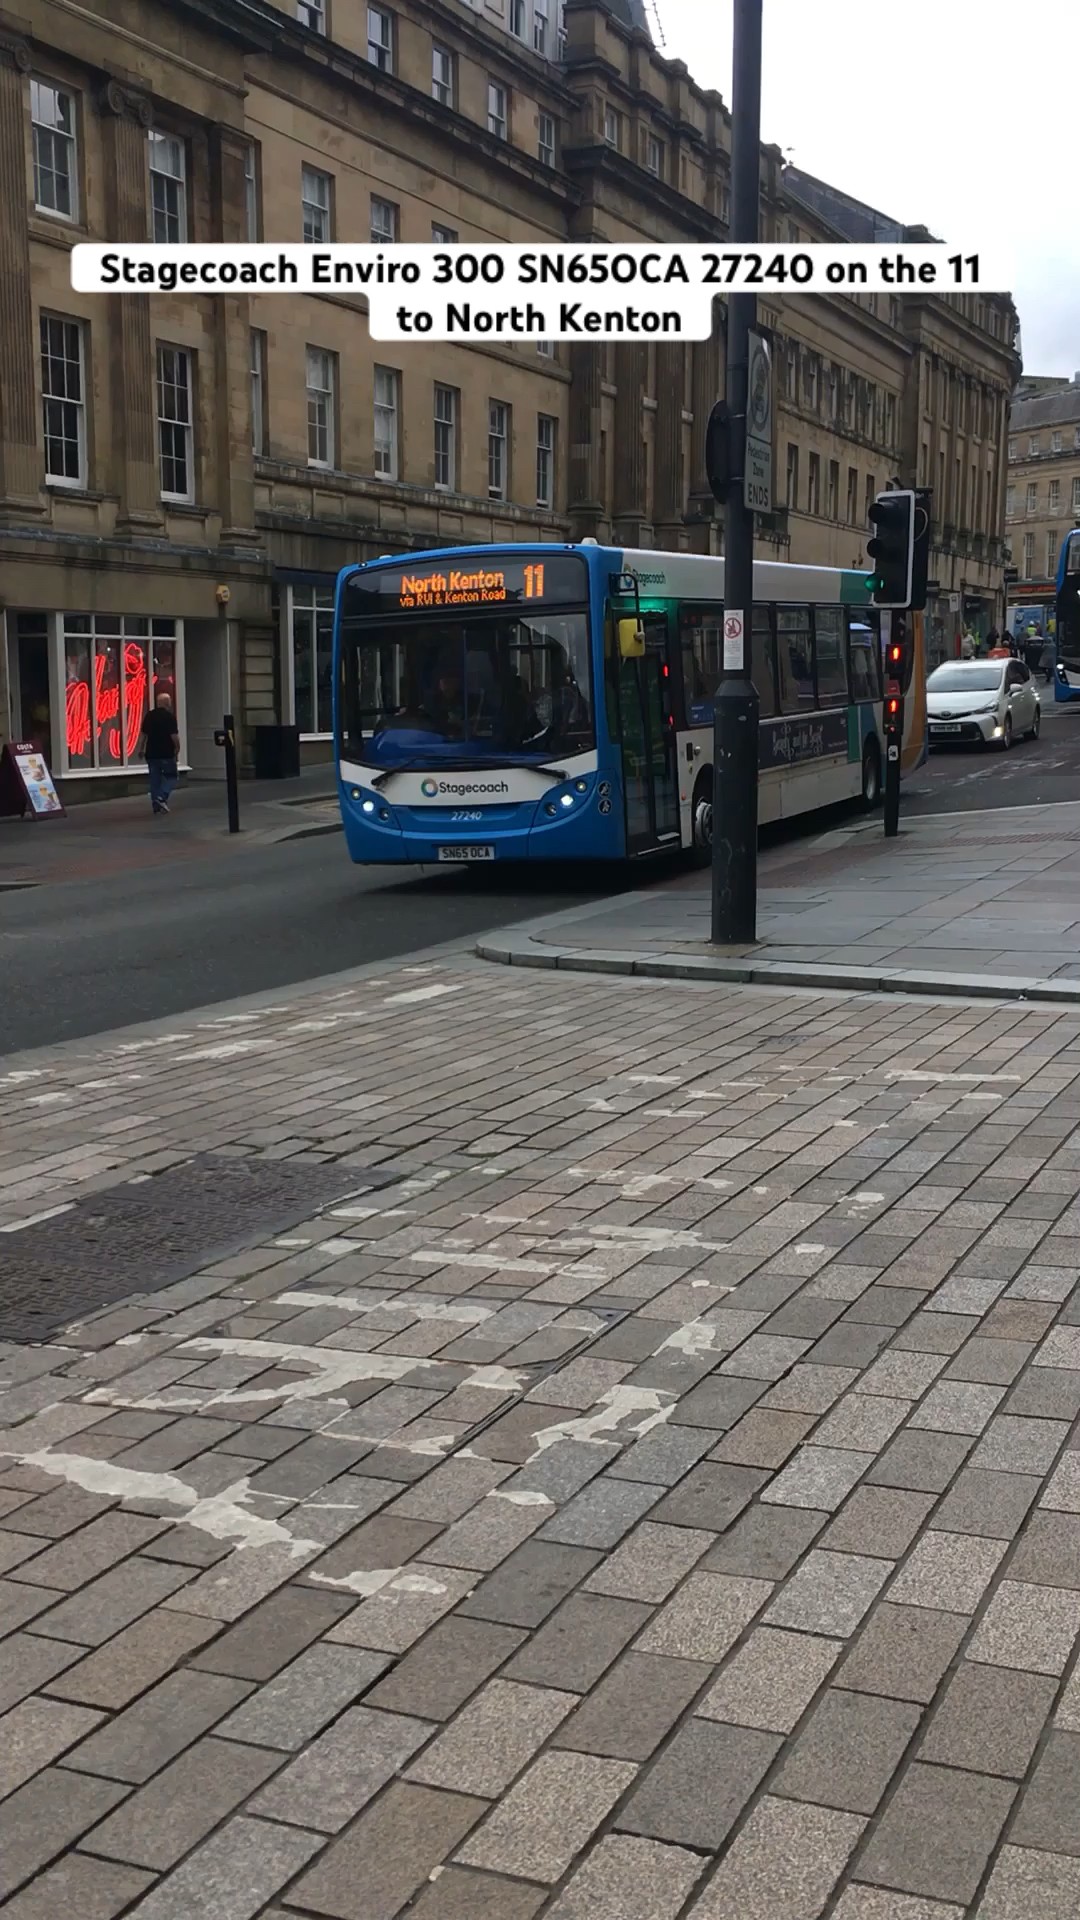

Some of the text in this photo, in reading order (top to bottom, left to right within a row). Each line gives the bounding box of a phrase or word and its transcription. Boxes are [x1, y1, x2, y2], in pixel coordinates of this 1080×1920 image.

[748, 483, 769, 507] ENDS
[401, 569, 504, 594] North Kenton
[524, 563, 544, 598] 11
[400, 587, 506, 608] via RVI & Kenton Road
[440, 780, 508, 797] Stagecoach
[451, 811, 482, 821] 27240
[443, 847, 490, 858] SN65 OCA
